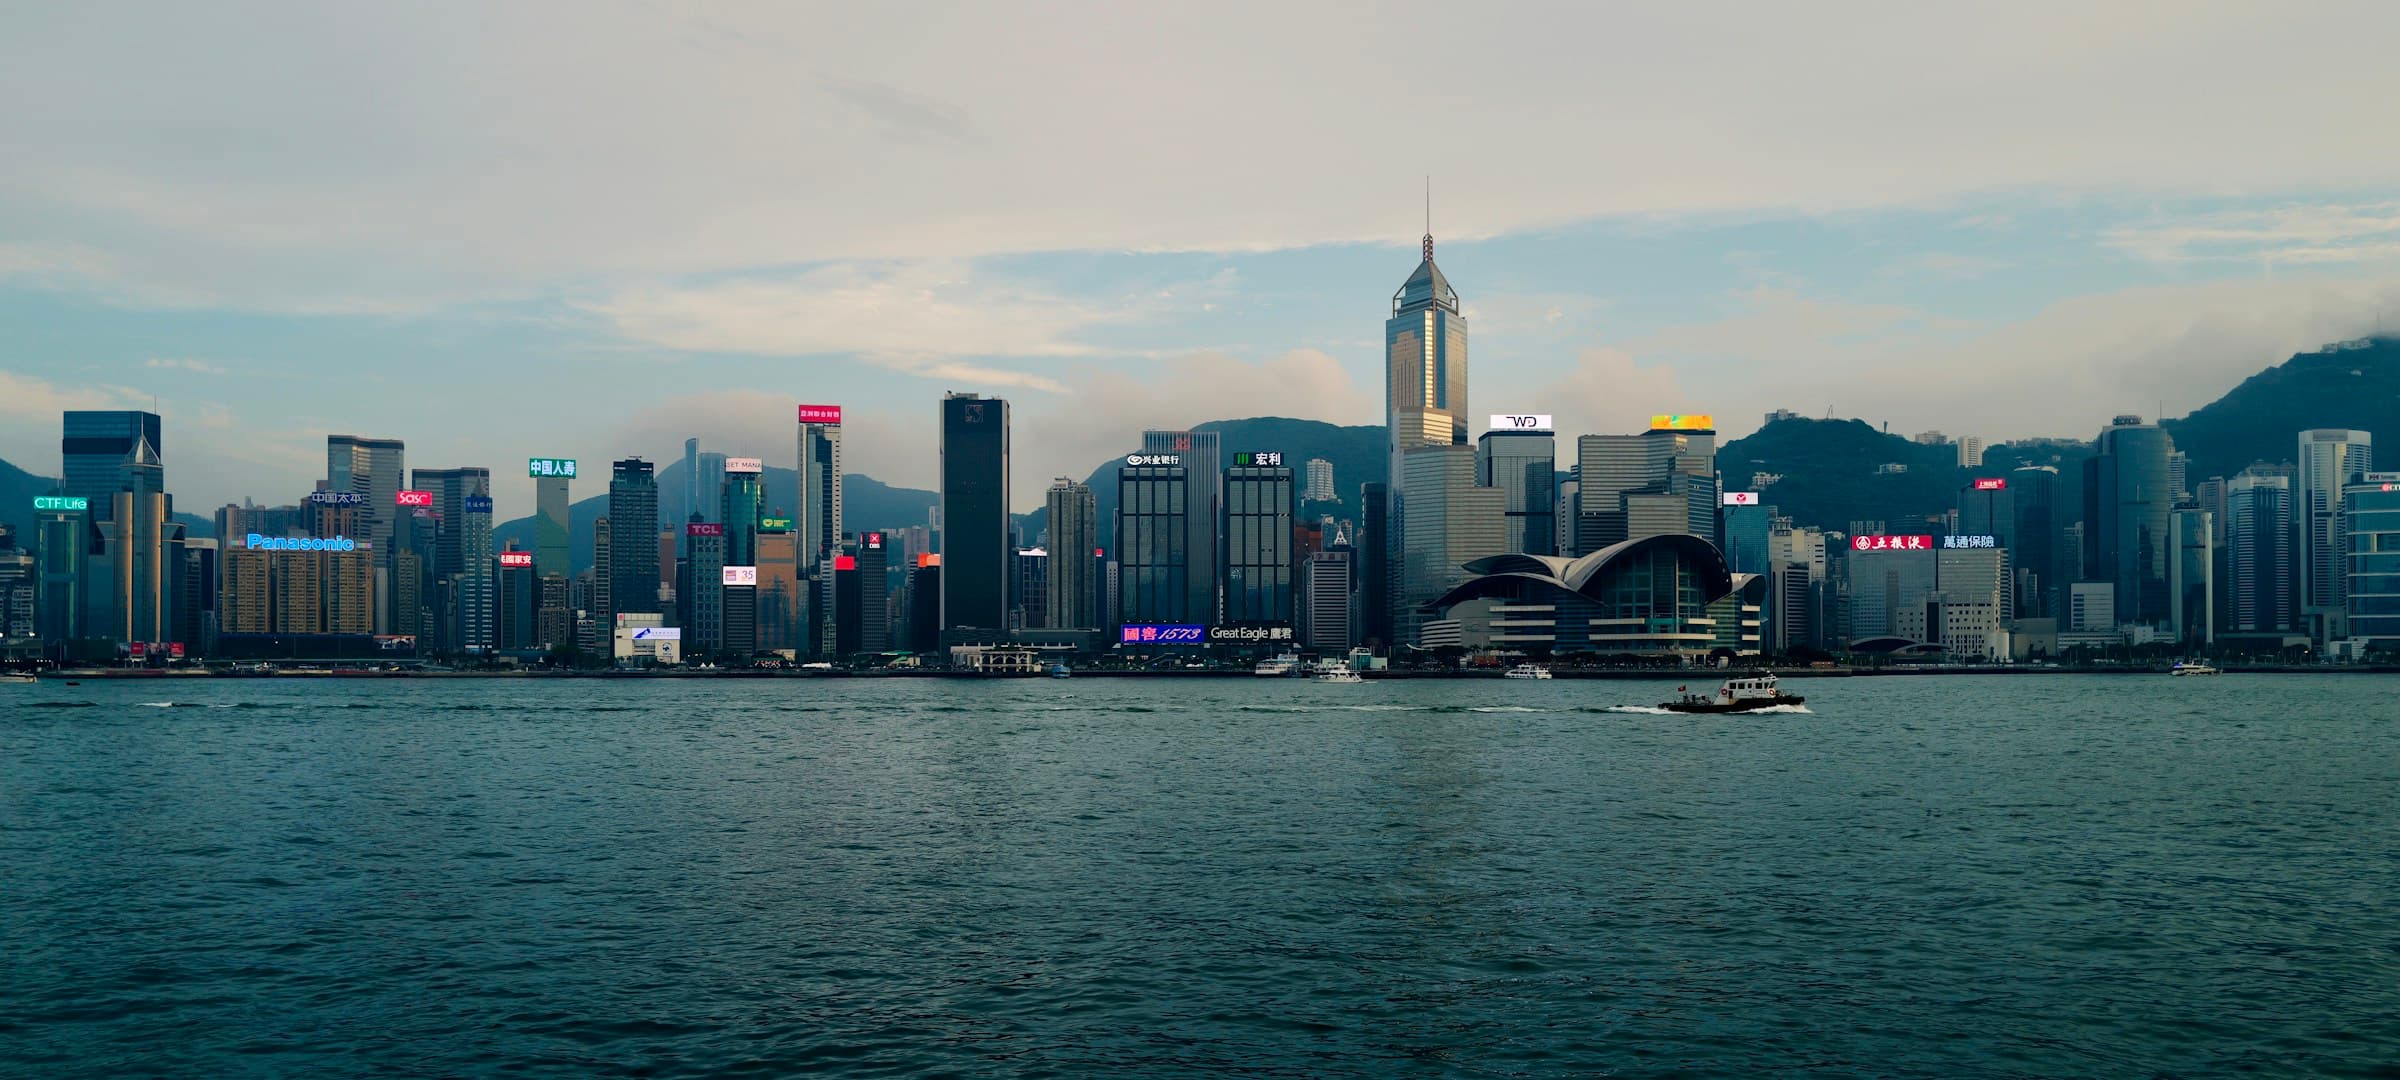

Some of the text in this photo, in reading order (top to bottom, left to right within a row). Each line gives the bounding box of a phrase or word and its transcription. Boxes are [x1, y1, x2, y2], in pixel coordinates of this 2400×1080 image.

[1142, 455, 1180, 465] 兴业银行
[1255, 452, 1281, 466] 宏利
[530, 459, 575, 476] 中国人寿
[34, 498, 88, 510] CTF Life
[312, 492, 362, 503] 中国太平
[692, 525, 719, 534] TCL
[247, 533, 354, 551] Panasonic
[1943, 535, 1995, 549] 萬通保險
[1210, 627, 1240, 639] Great
[1240, 627, 1268, 642] Eagle
